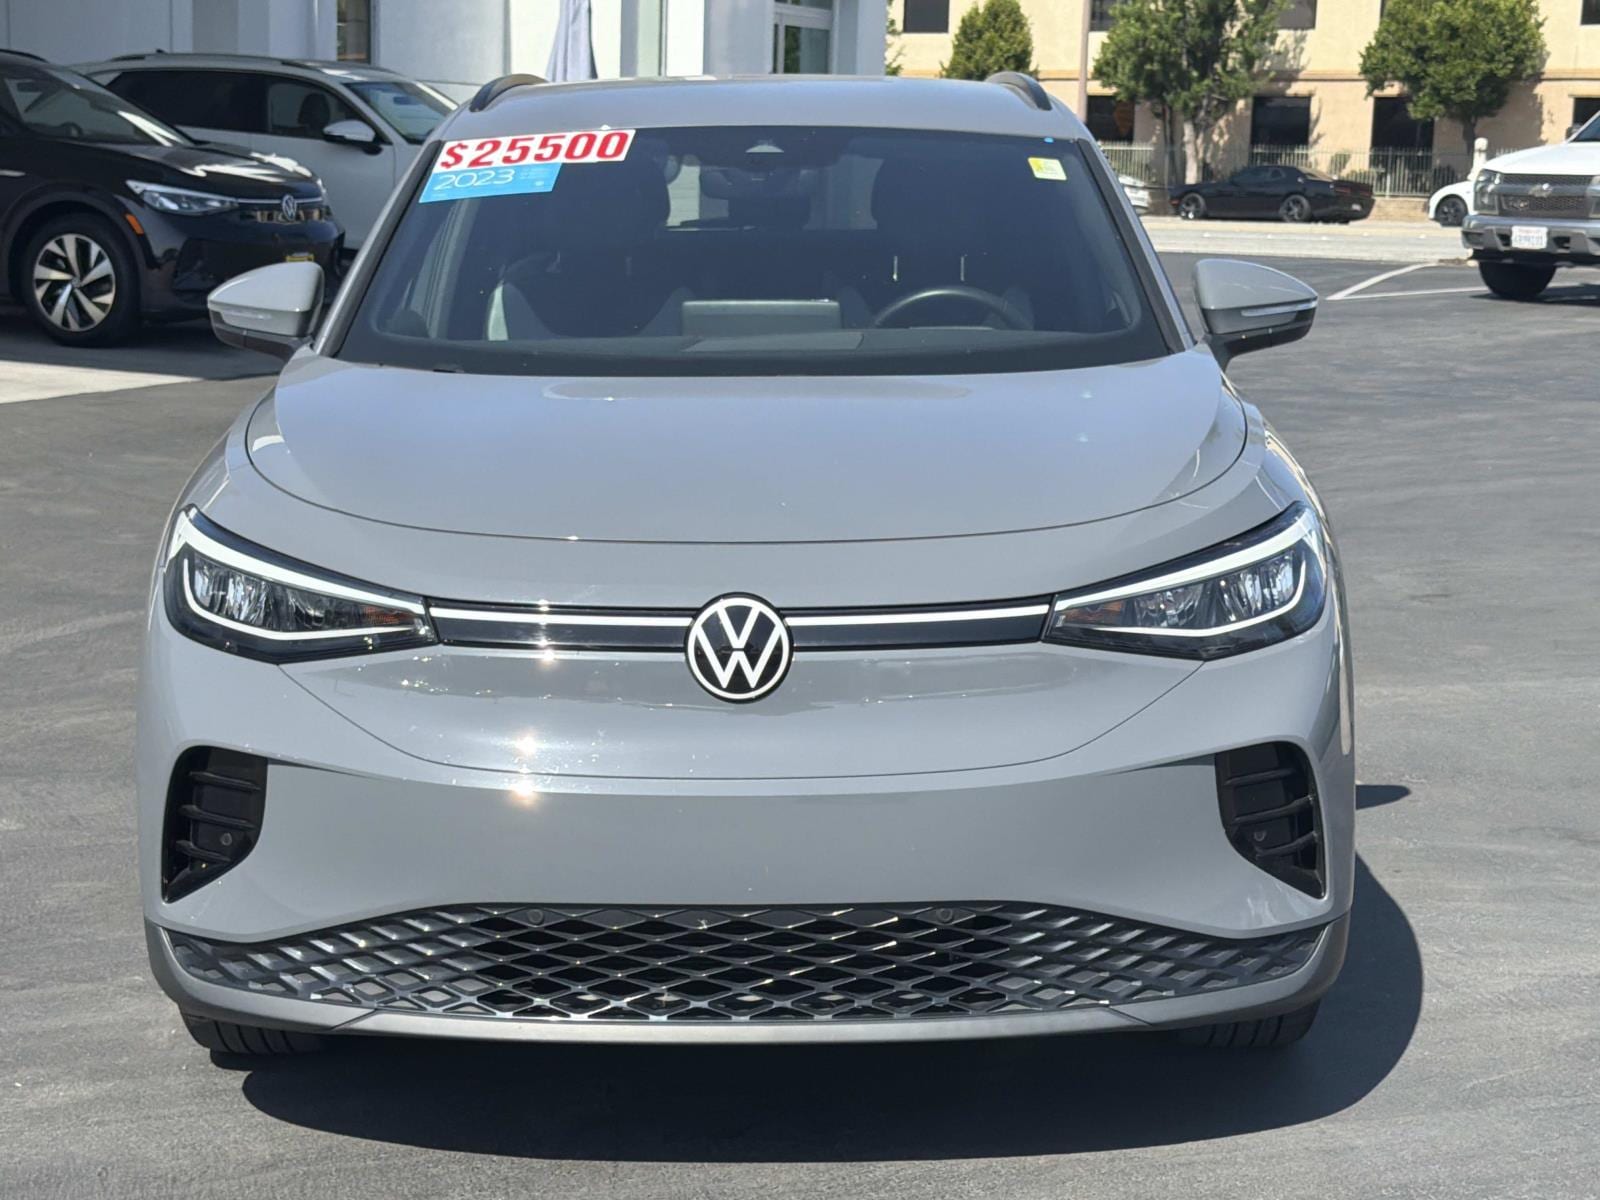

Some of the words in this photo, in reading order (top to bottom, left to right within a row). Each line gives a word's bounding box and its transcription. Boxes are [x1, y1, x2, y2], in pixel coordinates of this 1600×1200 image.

[440, 131, 630, 169] $25500
[435, 169, 515, 190] 2023
[687, 597, 790, 700] VW
